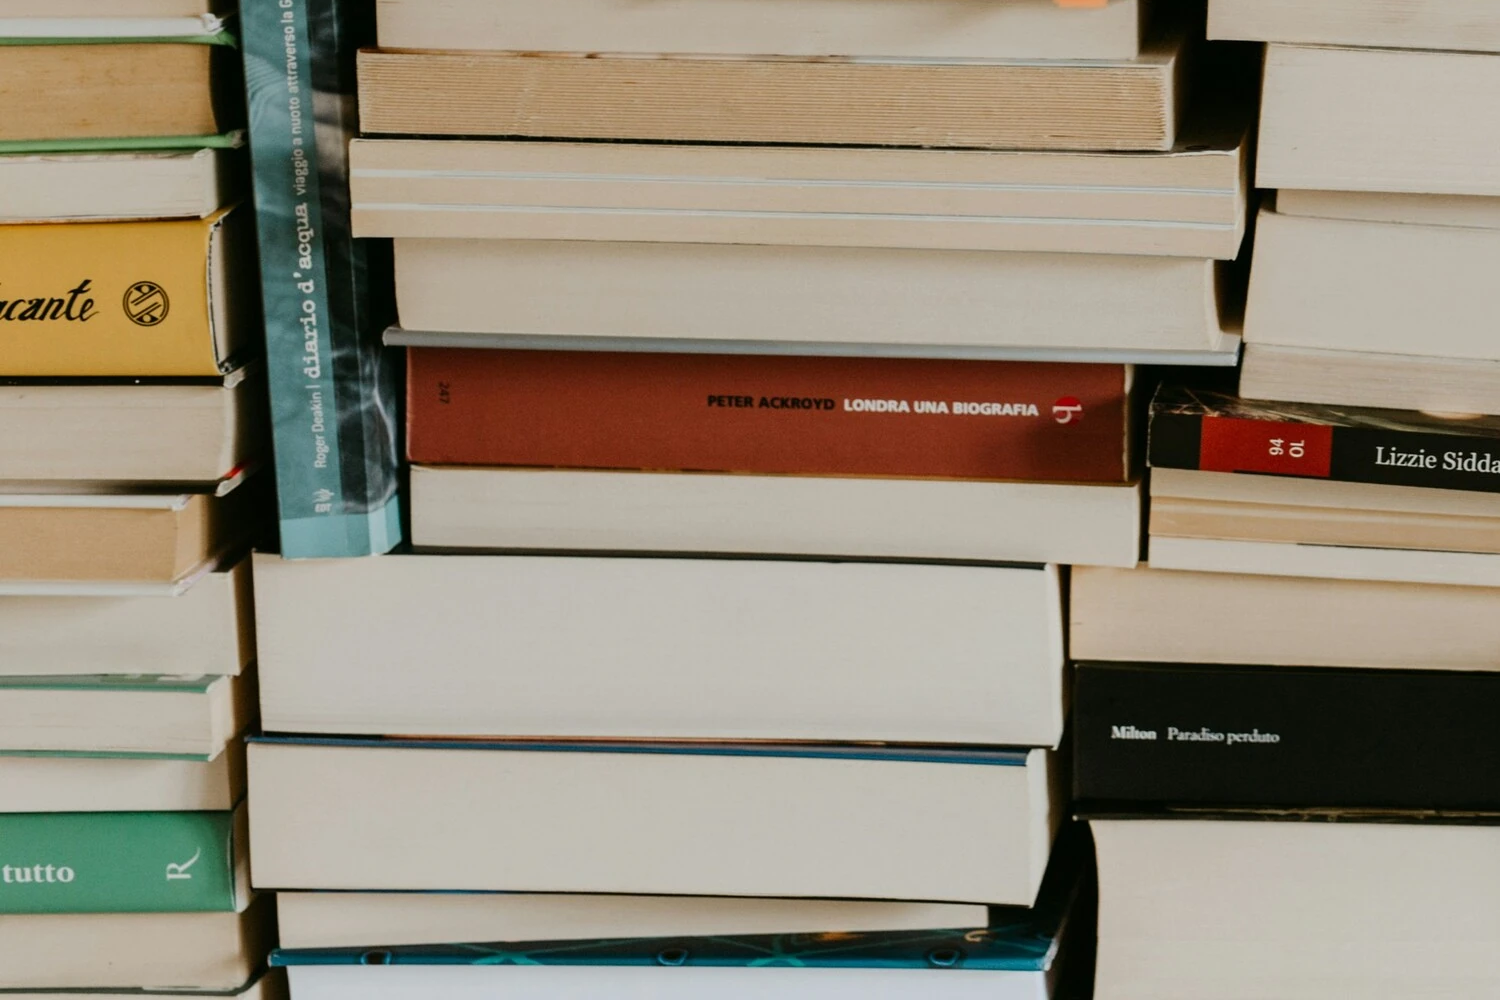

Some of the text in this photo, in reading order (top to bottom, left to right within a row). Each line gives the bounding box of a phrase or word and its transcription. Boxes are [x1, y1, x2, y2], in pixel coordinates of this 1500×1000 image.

[280, 11, 294, 24] la
[285, 26, 300, 94] attraverso
[289, 96, 302, 135] nuoto
[291, 149, 308, 196] viaggio
[0, 279, 100, 322] cante
[300, 300, 320, 379] diario
[707, 395, 1039, 417] PETER ACKROYD LONDRA UNA BIOGRAFIA
[309, 391, 329, 469] Roger Deakin
[1268, 438, 1284, 456] 94
[1289, 440, 1304, 458] OL
[1375, 446, 1437, 469] Lizzie
[1111, 725, 1280, 746] Milton Paradiso perduto
[2, 864, 75, 883] tutto
